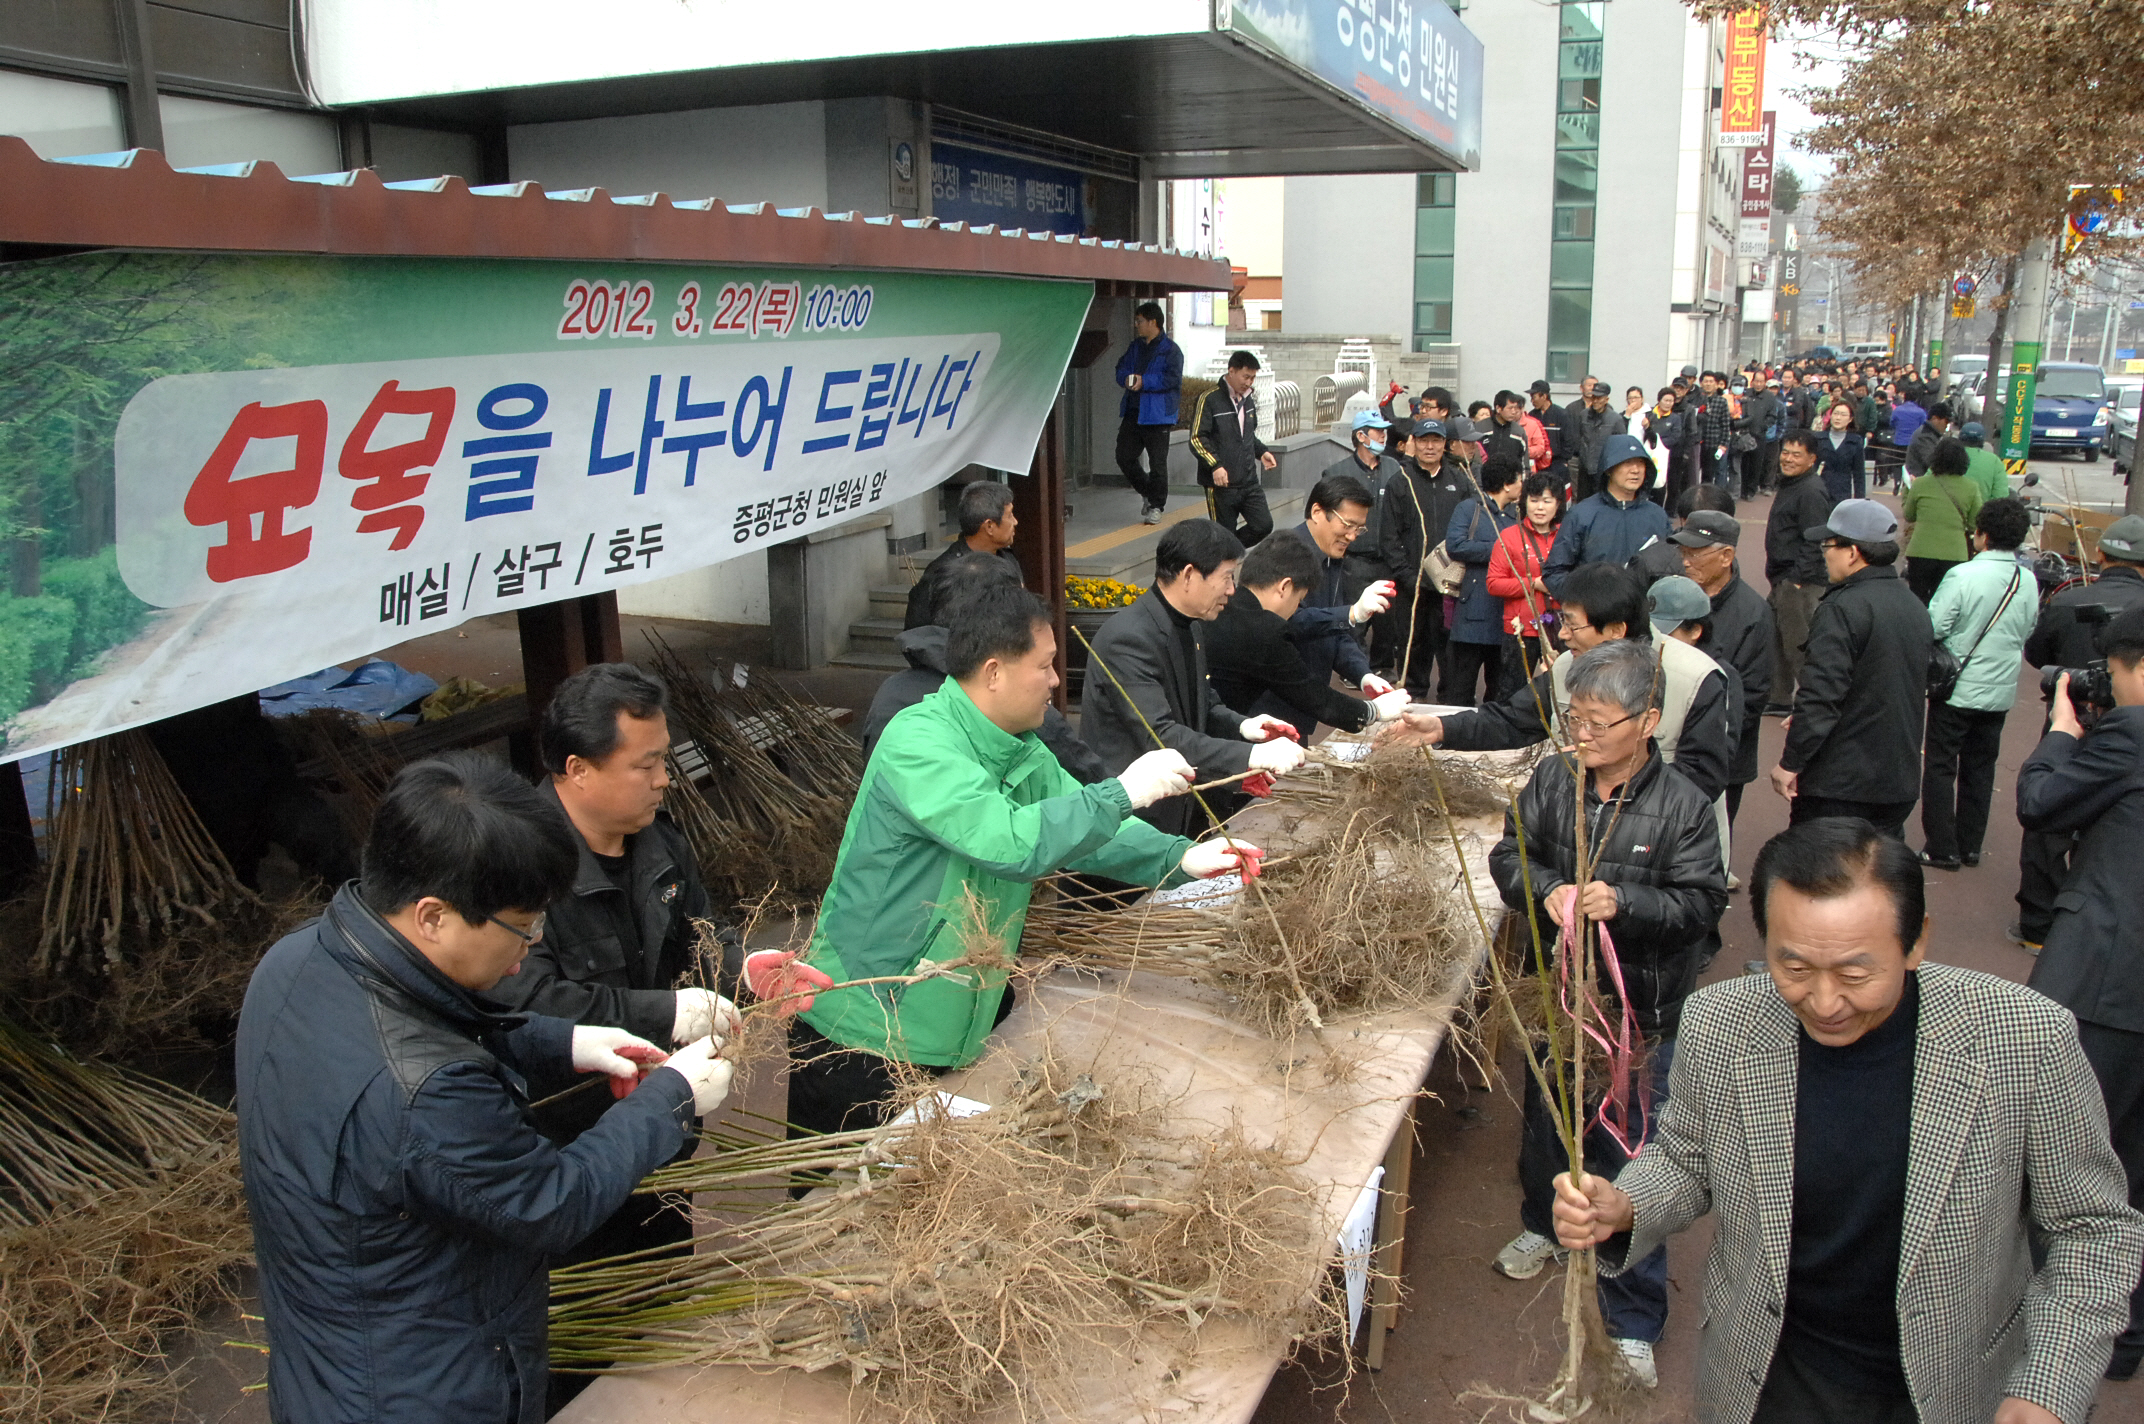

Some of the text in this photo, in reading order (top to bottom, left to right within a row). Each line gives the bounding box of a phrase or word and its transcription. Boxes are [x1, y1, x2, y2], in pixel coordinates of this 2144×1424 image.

[1420, 18, 1459, 120] 민원실
[1720, 134, 1761, 144] 836-9199
[561, 283, 872, 336] 2012. 3. 22(목) 10:00
[2015, 380, 2027, 415] CCTV
[183, 350, 981, 584] 묘목을 나누어 드립니다
[733, 468, 888, 545] 증평군청 민원실 앞
[379, 562, 450, 626] 매실
[493, 542, 563, 599] 살구
[604, 523, 664, 576] 호두
